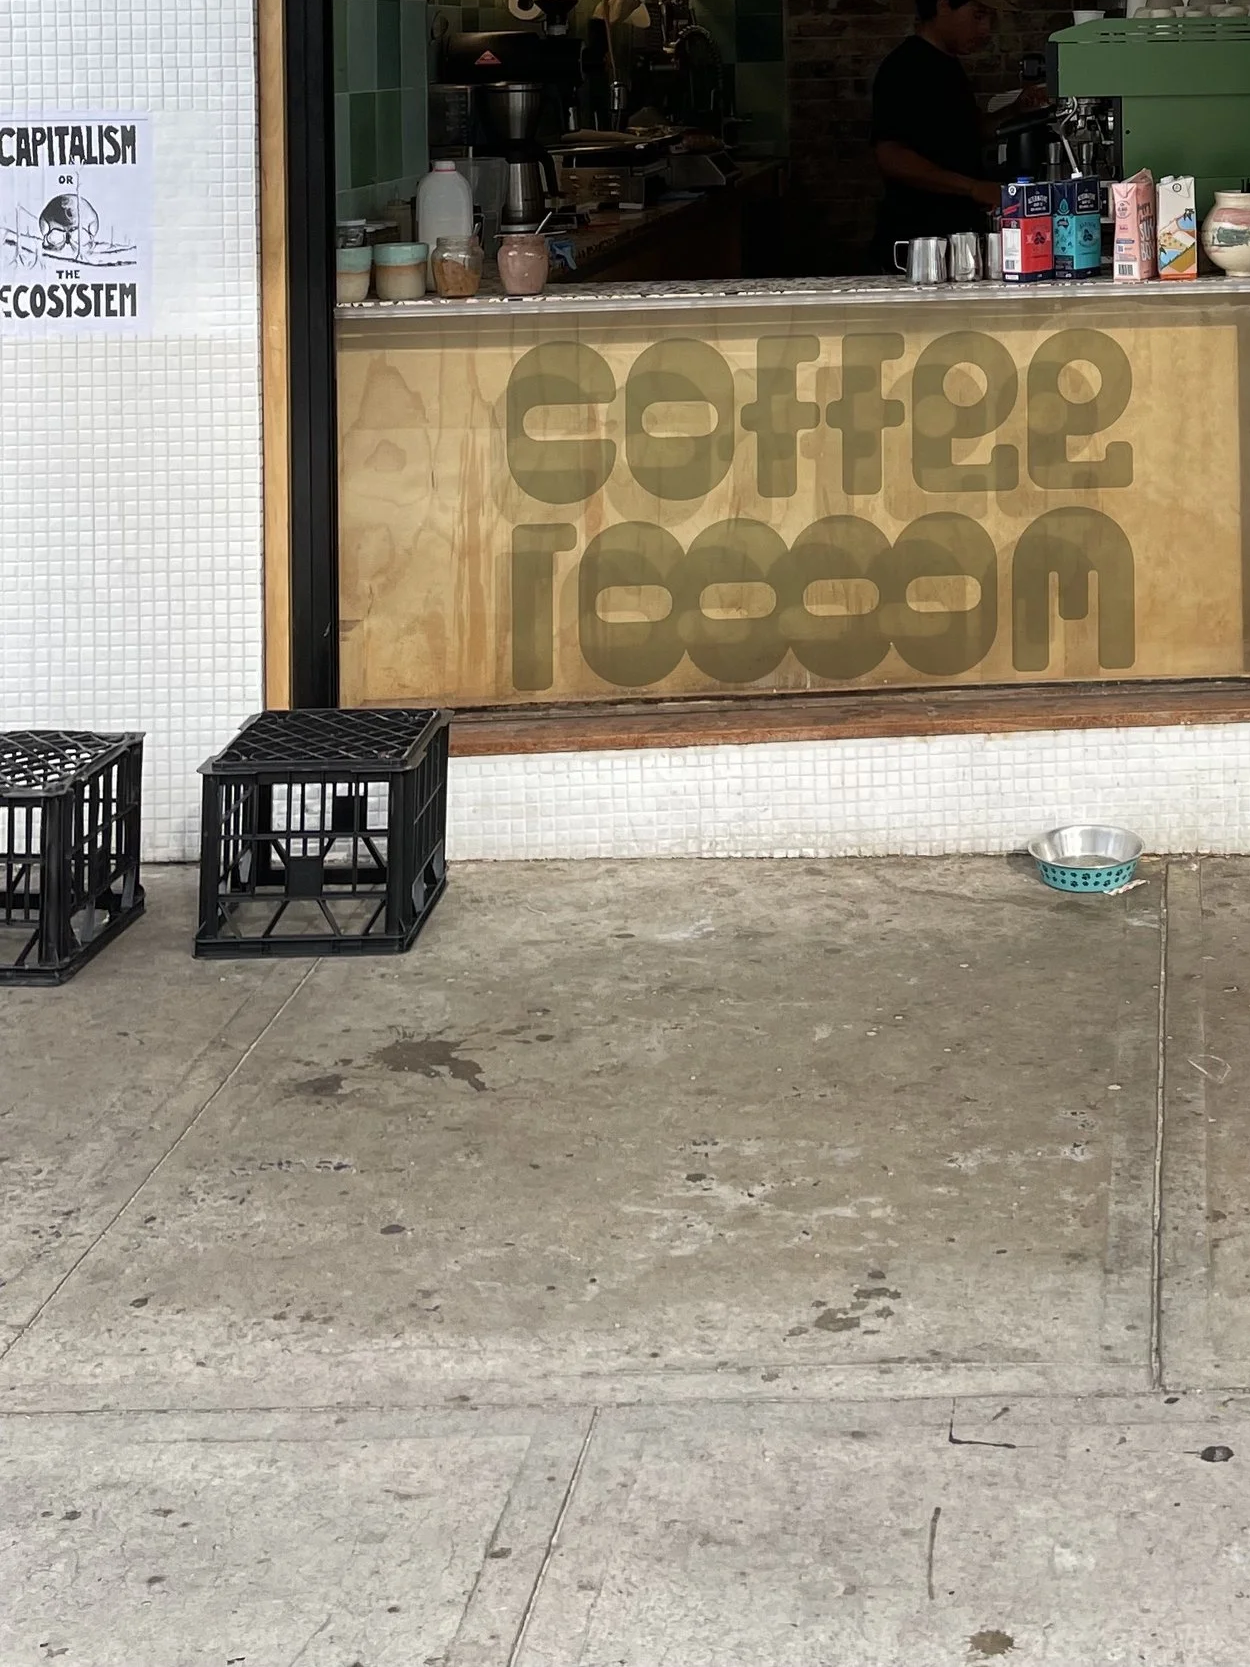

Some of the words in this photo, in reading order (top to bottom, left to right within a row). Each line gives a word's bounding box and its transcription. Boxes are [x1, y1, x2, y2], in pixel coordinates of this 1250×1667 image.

[0, 125, 136, 167] CAPITALISM
[58, 175, 73, 184] OR
[56, 270, 80, 279] THE
[506, 328, 1133, 505] coffee
